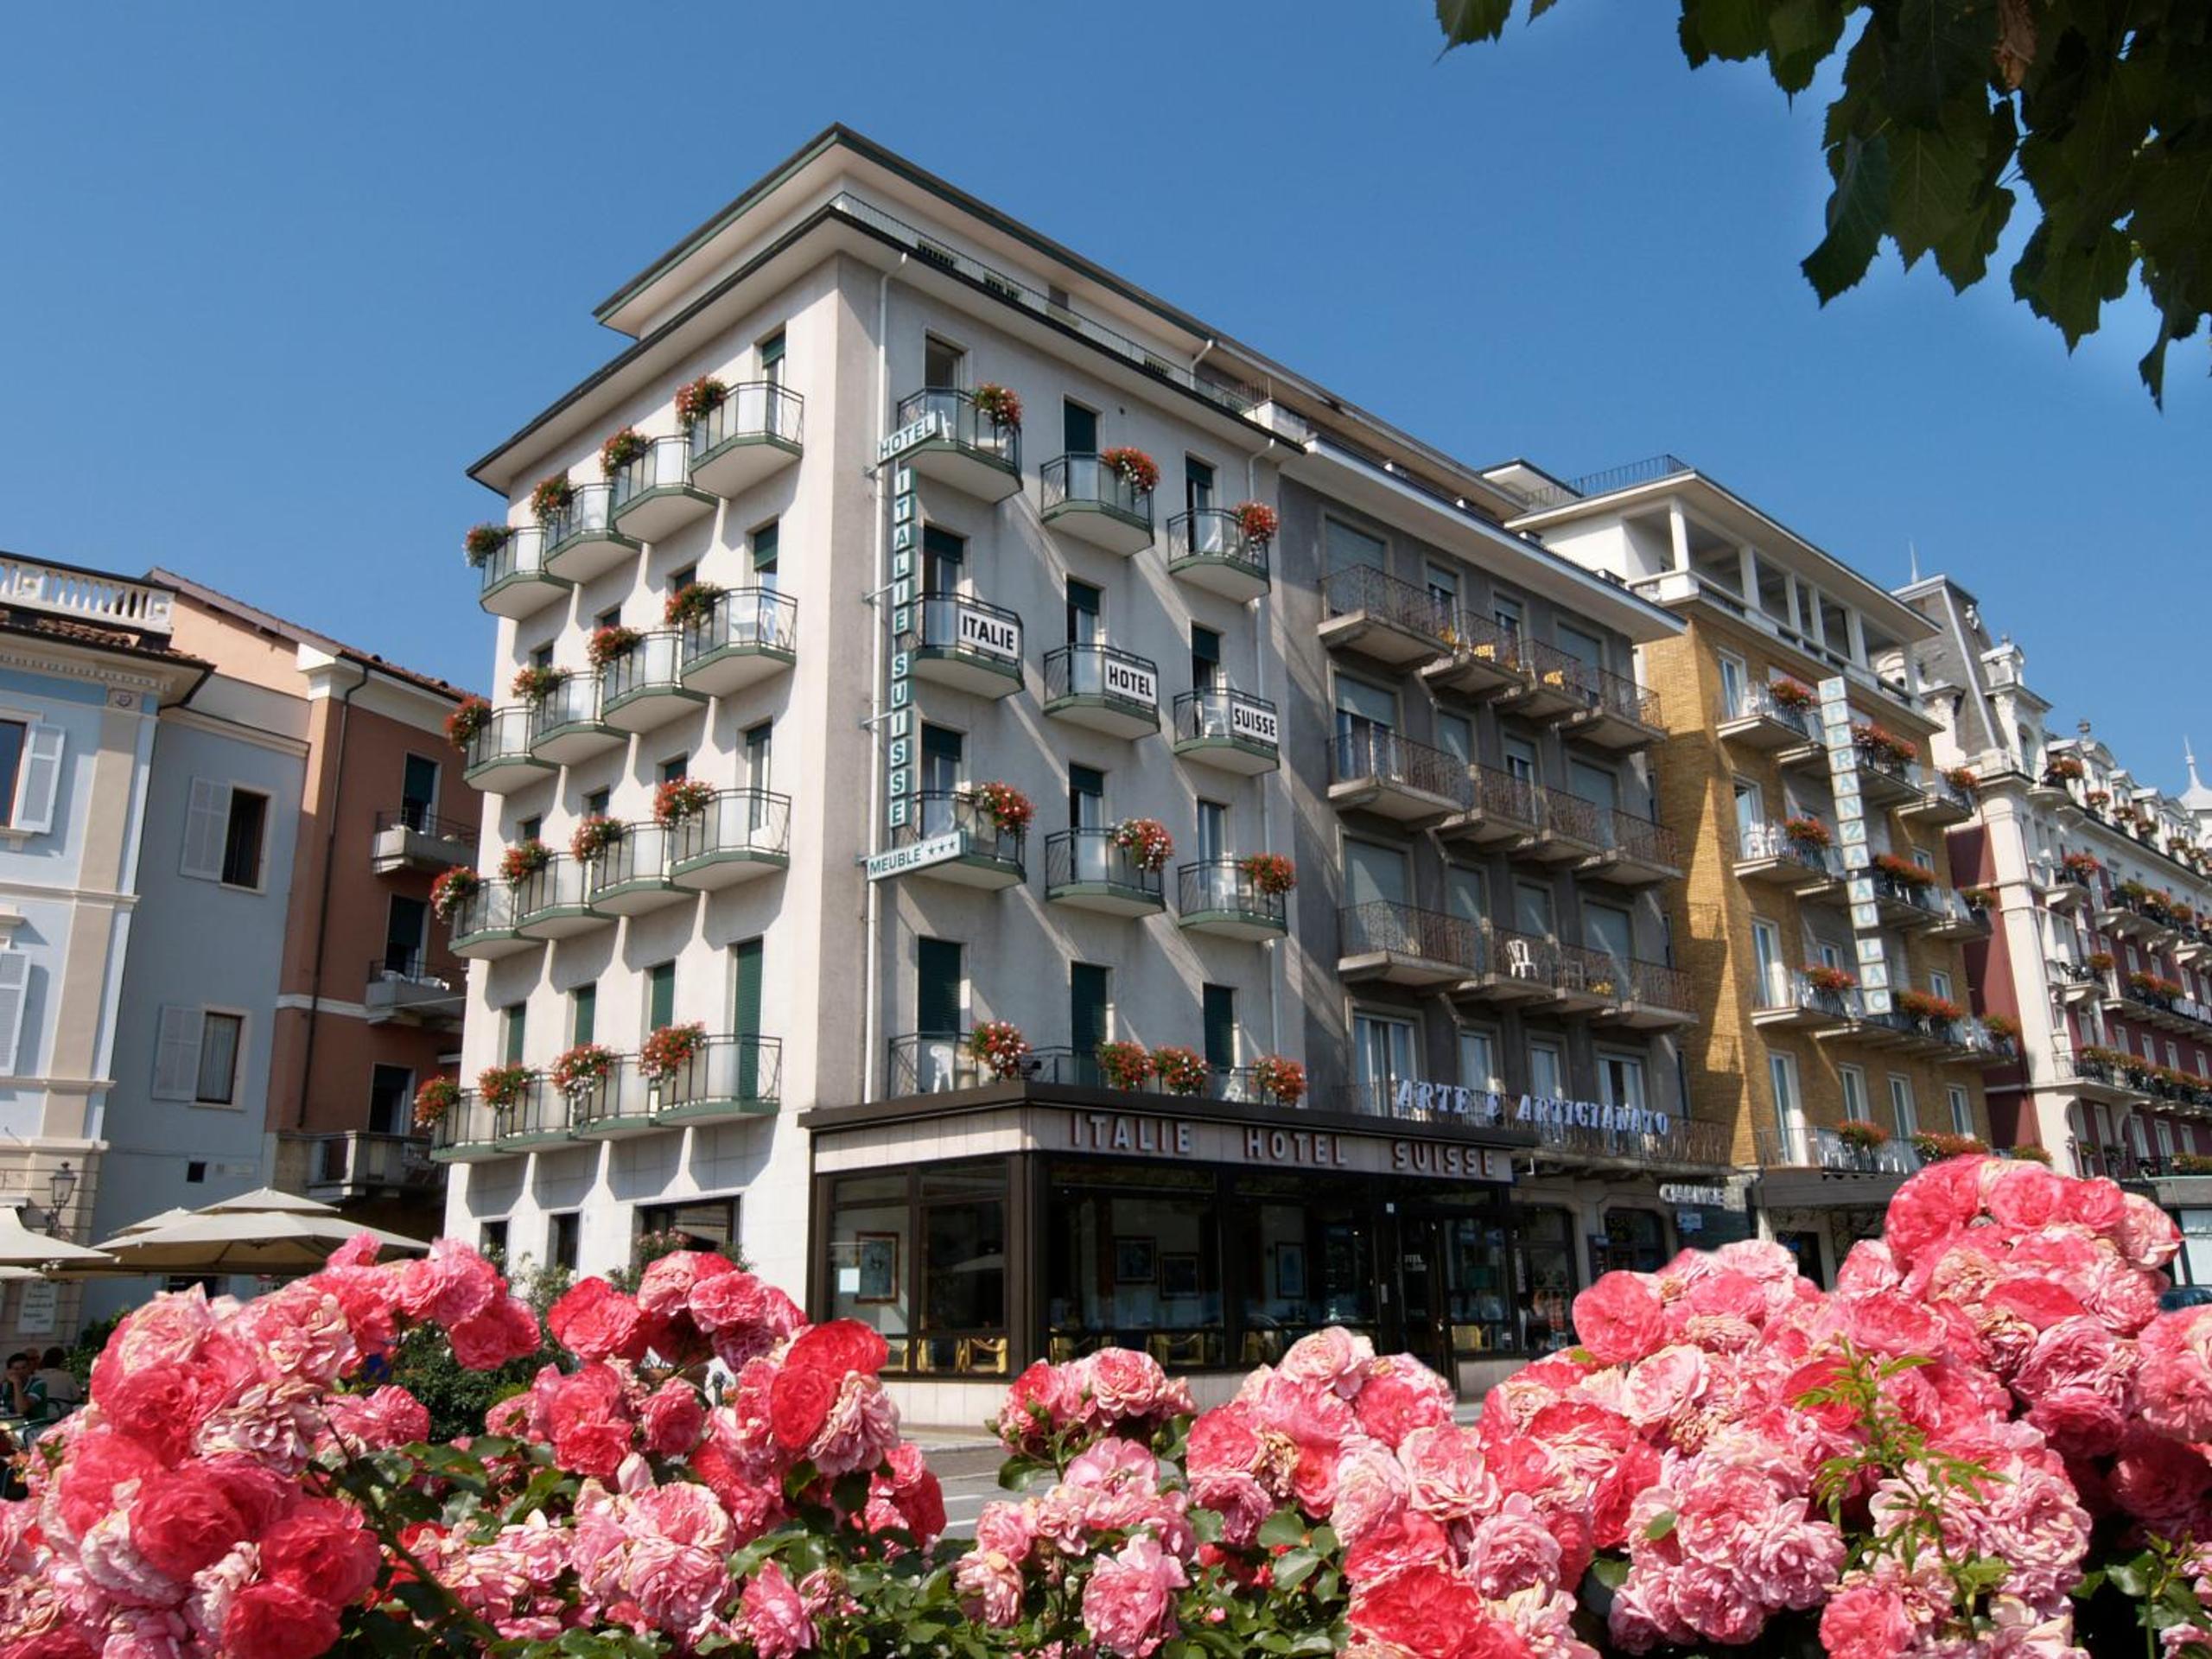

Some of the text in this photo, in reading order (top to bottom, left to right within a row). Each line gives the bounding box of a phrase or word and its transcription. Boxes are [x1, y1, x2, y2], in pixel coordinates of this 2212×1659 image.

[879, 419, 932, 461] HOTEL
[890, 473, 908, 824] ITALIE SUISSE
[962, 614, 1014, 651] ITALIE
[1108, 664, 1153, 696] HOTEL
[1235, 708, 1275, 737] SUISSE
[1823, 678, 1888, 1010] SPERANZA AU LAC
[1395, 1079, 1669, 1136] ARTE E ARTIGIANATO
[1071, 1111, 1494, 1178] ITALIE HOTEL SUISSE
